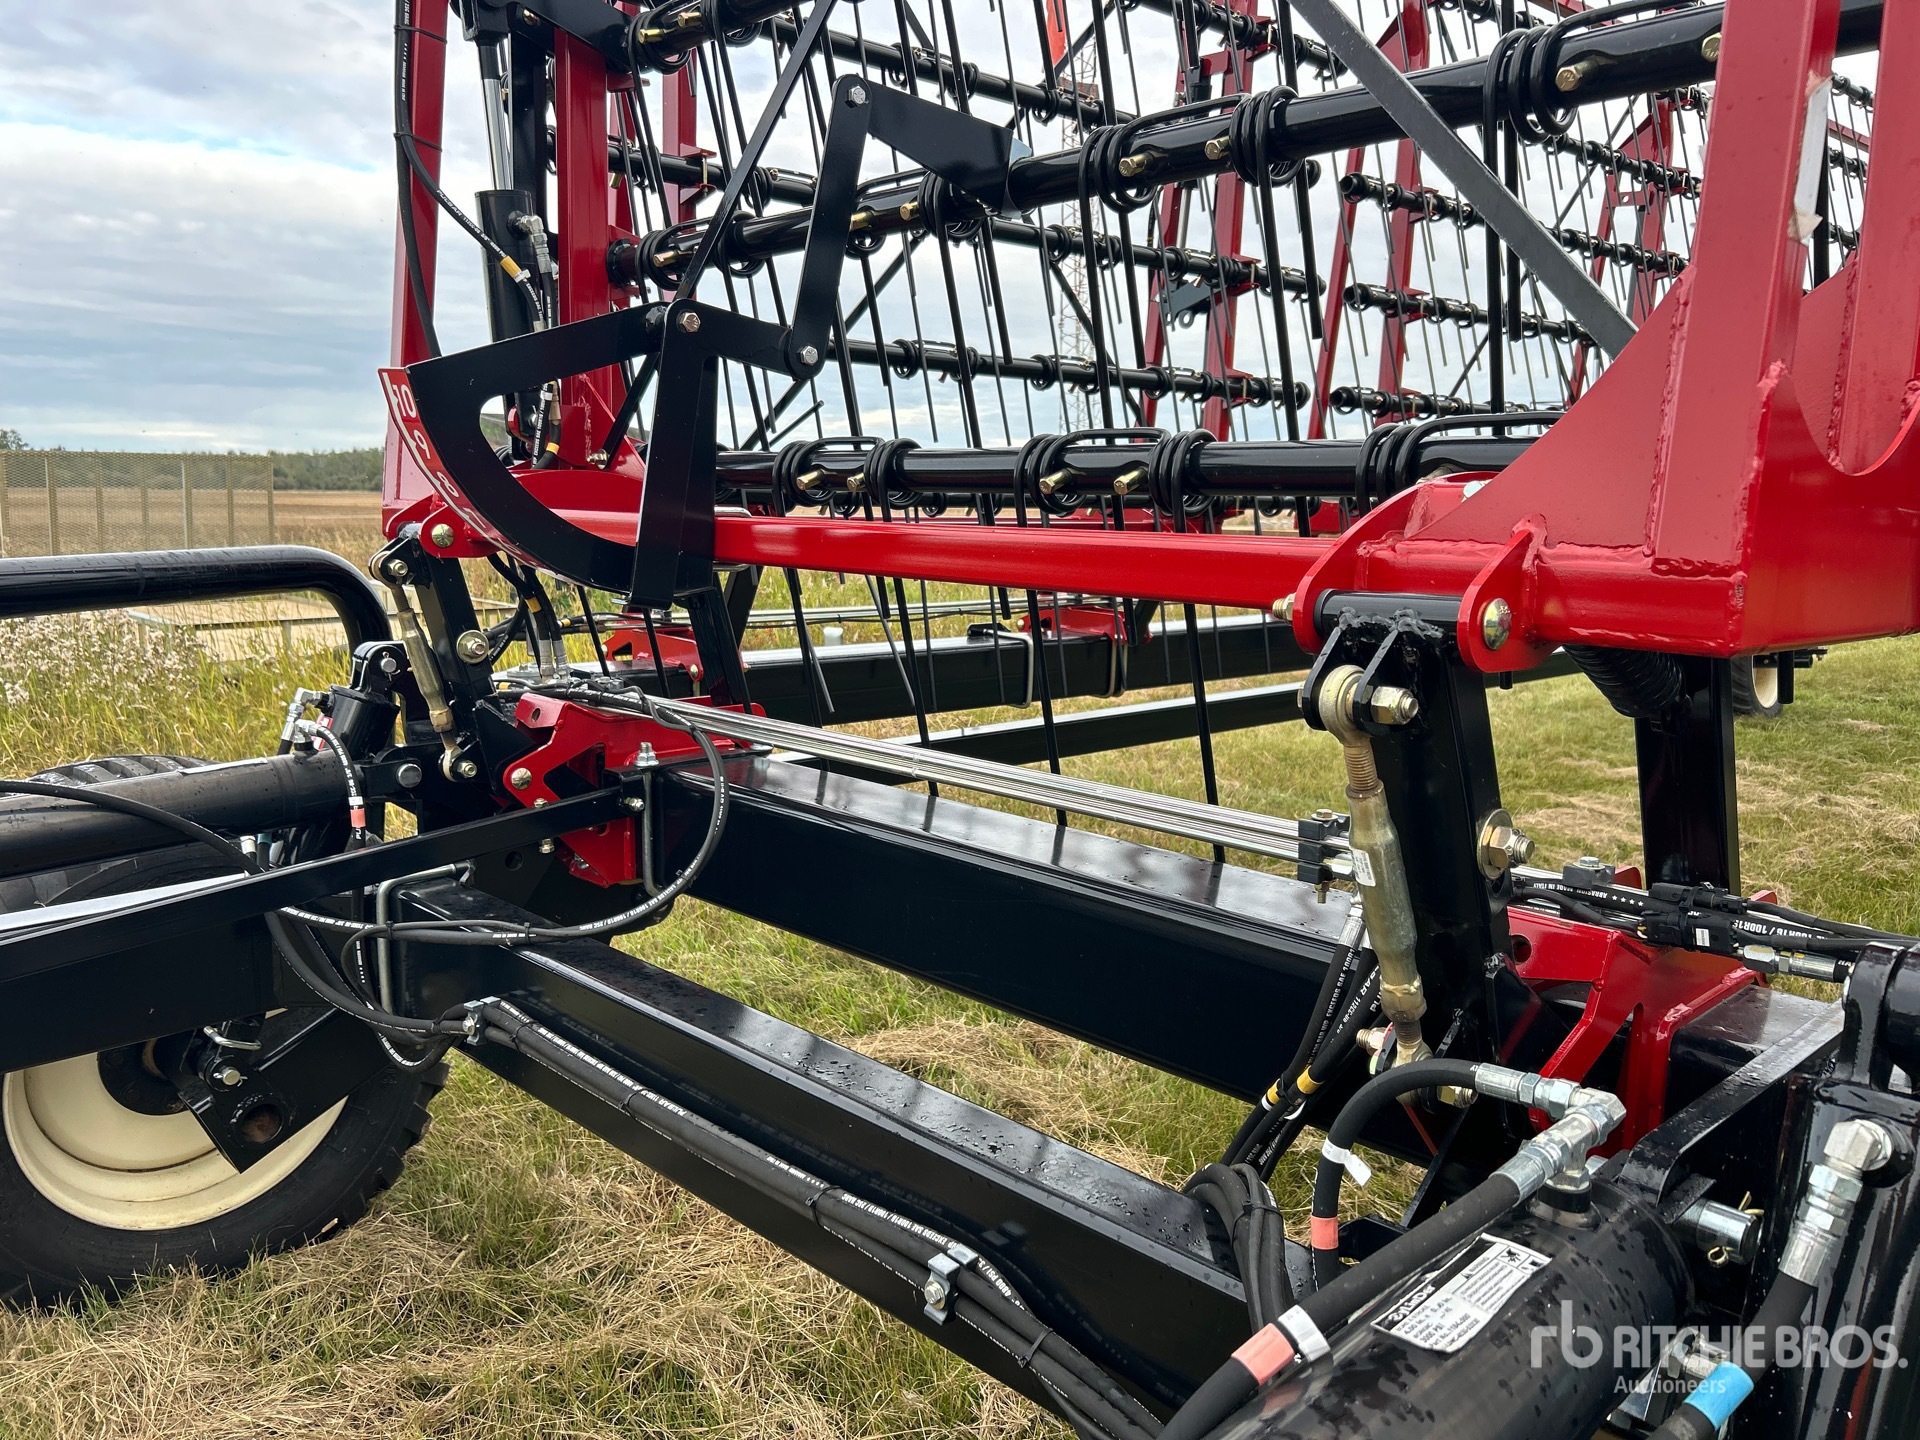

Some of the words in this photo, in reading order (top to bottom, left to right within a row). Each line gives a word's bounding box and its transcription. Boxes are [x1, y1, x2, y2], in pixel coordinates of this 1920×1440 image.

[392, 384, 417, 418] 10
[413, 429, 431, 459] 9
[436, 471, 460, 498] 8
[1342, 949, 1354, 971] 100R1
[910, 1223, 924, 1234] SAE
[922, 1228, 947, 1245] EXCEEDS
[985, 1267, 998, 1281] PSI
[994, 1278, 1012, 1298] 4800
